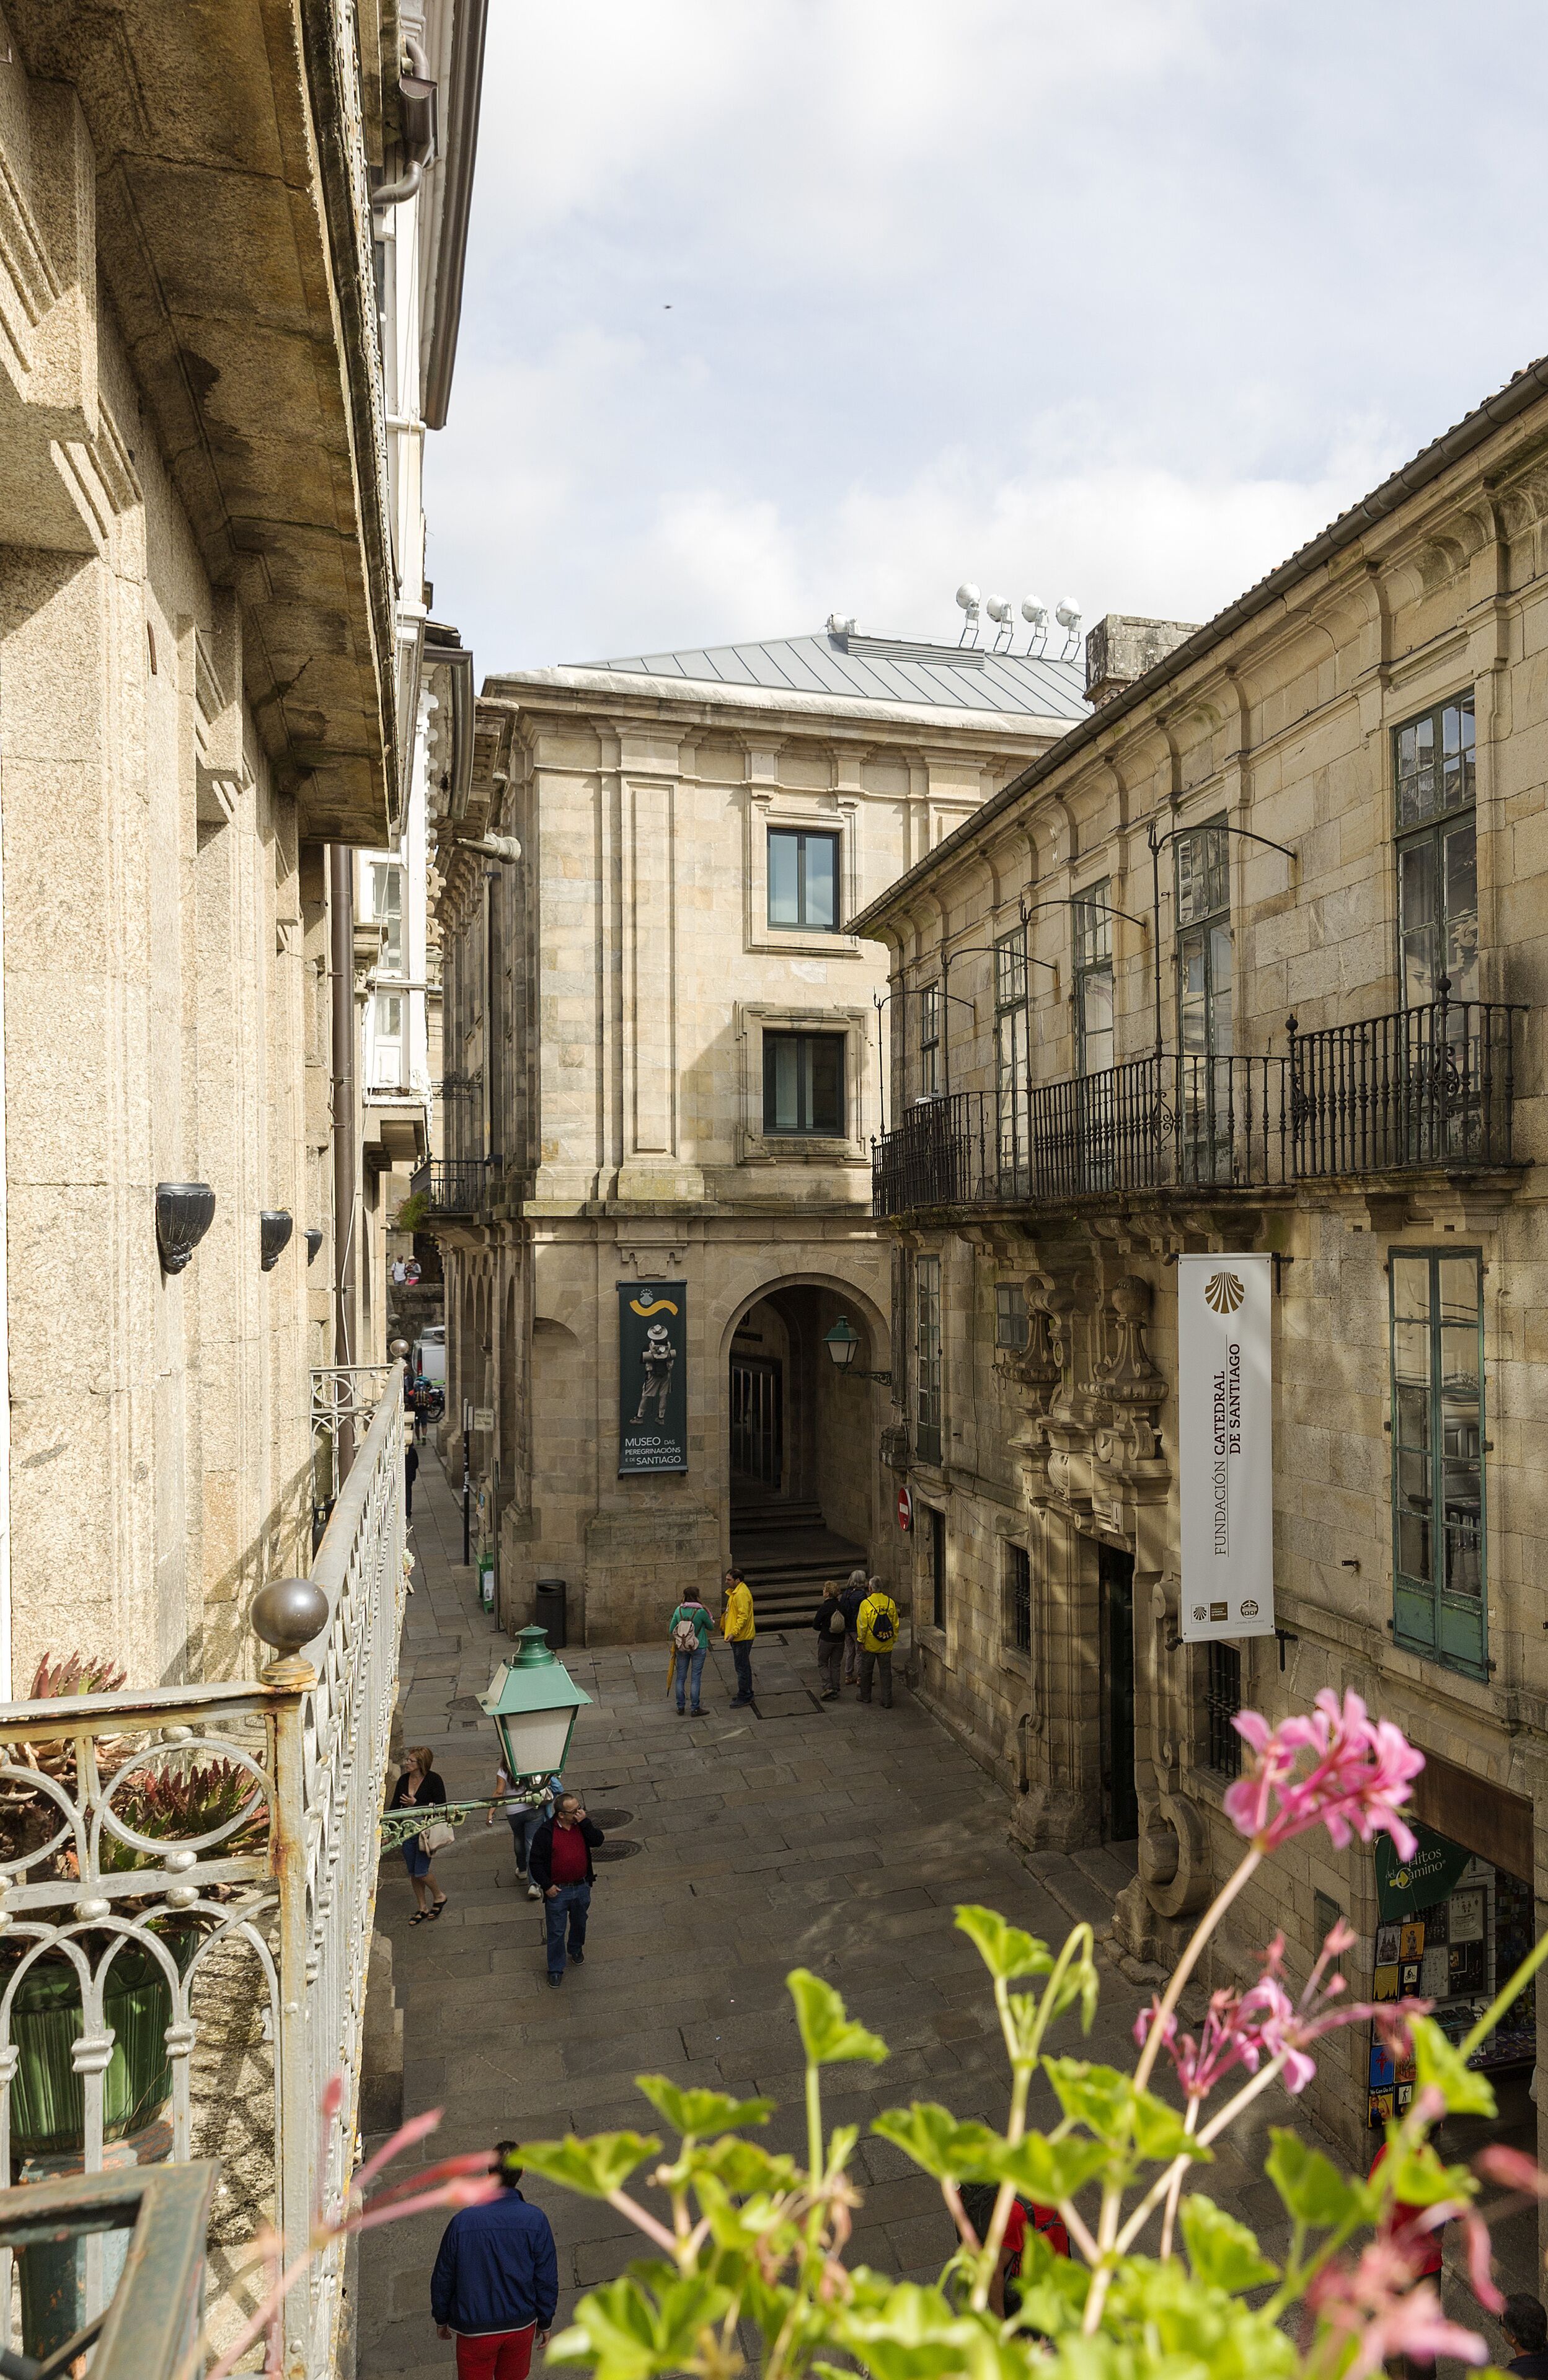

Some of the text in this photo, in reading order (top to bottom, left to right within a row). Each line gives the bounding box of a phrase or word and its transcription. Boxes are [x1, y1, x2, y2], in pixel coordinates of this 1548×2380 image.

[1227, 1343, 1241, 1455] DE SANTIAGO
[625, 1437, 661, 1447] MUSEO
[625, 1446, 681, 1455] PEREGRINACIÓNS
[636, 1455, 681, 1465] SANTIAGO
[1211, 1370, 1226, 1556] FUNDACIÓN CATEDRAL
[1409, 1848, 1441, 1867] Hitos
[1386, 1861, 1443, 1889] del Camino
